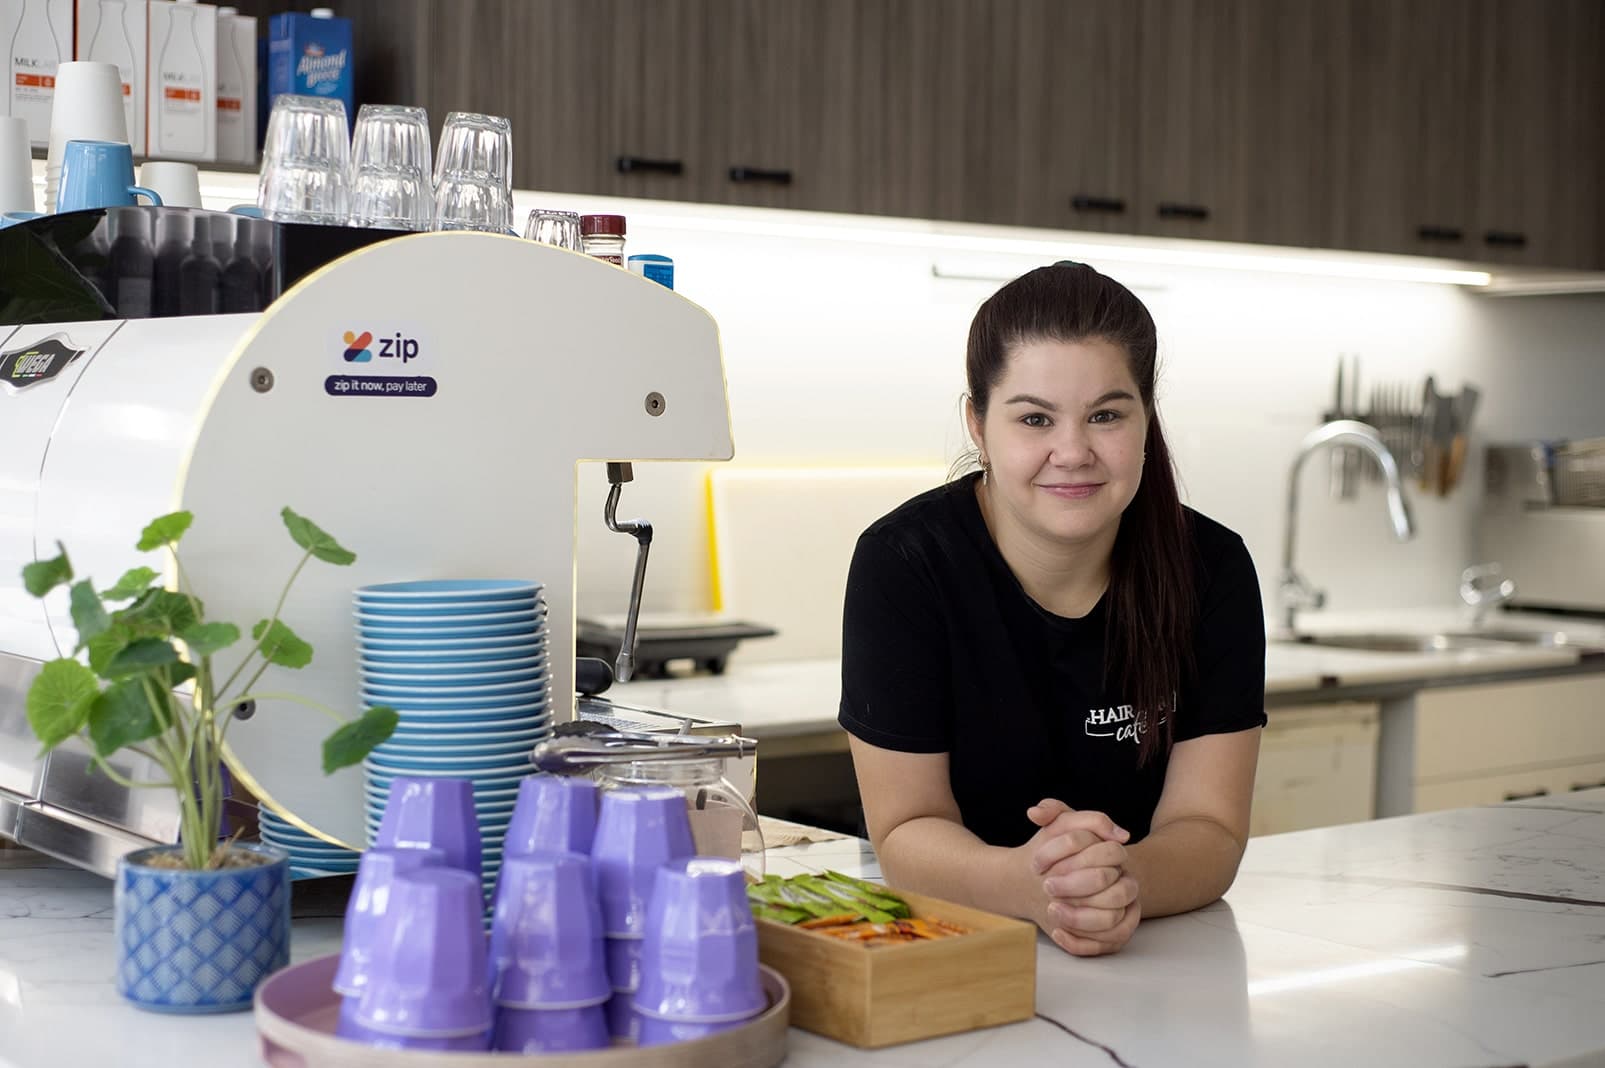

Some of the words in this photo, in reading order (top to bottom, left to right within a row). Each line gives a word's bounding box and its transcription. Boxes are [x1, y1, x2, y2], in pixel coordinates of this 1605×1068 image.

[296, 49, 347, 77] Almond
[379, 332, 419, 363] zip
[334, 379, 350, 392] zip
[351, 380, 359, 391] it
[361, 381, 385, 392] now,
[386, 382, 404, 393] pay
[405, 381, 427, 391] later
[1089, 704, 1135, 725] HAIR
